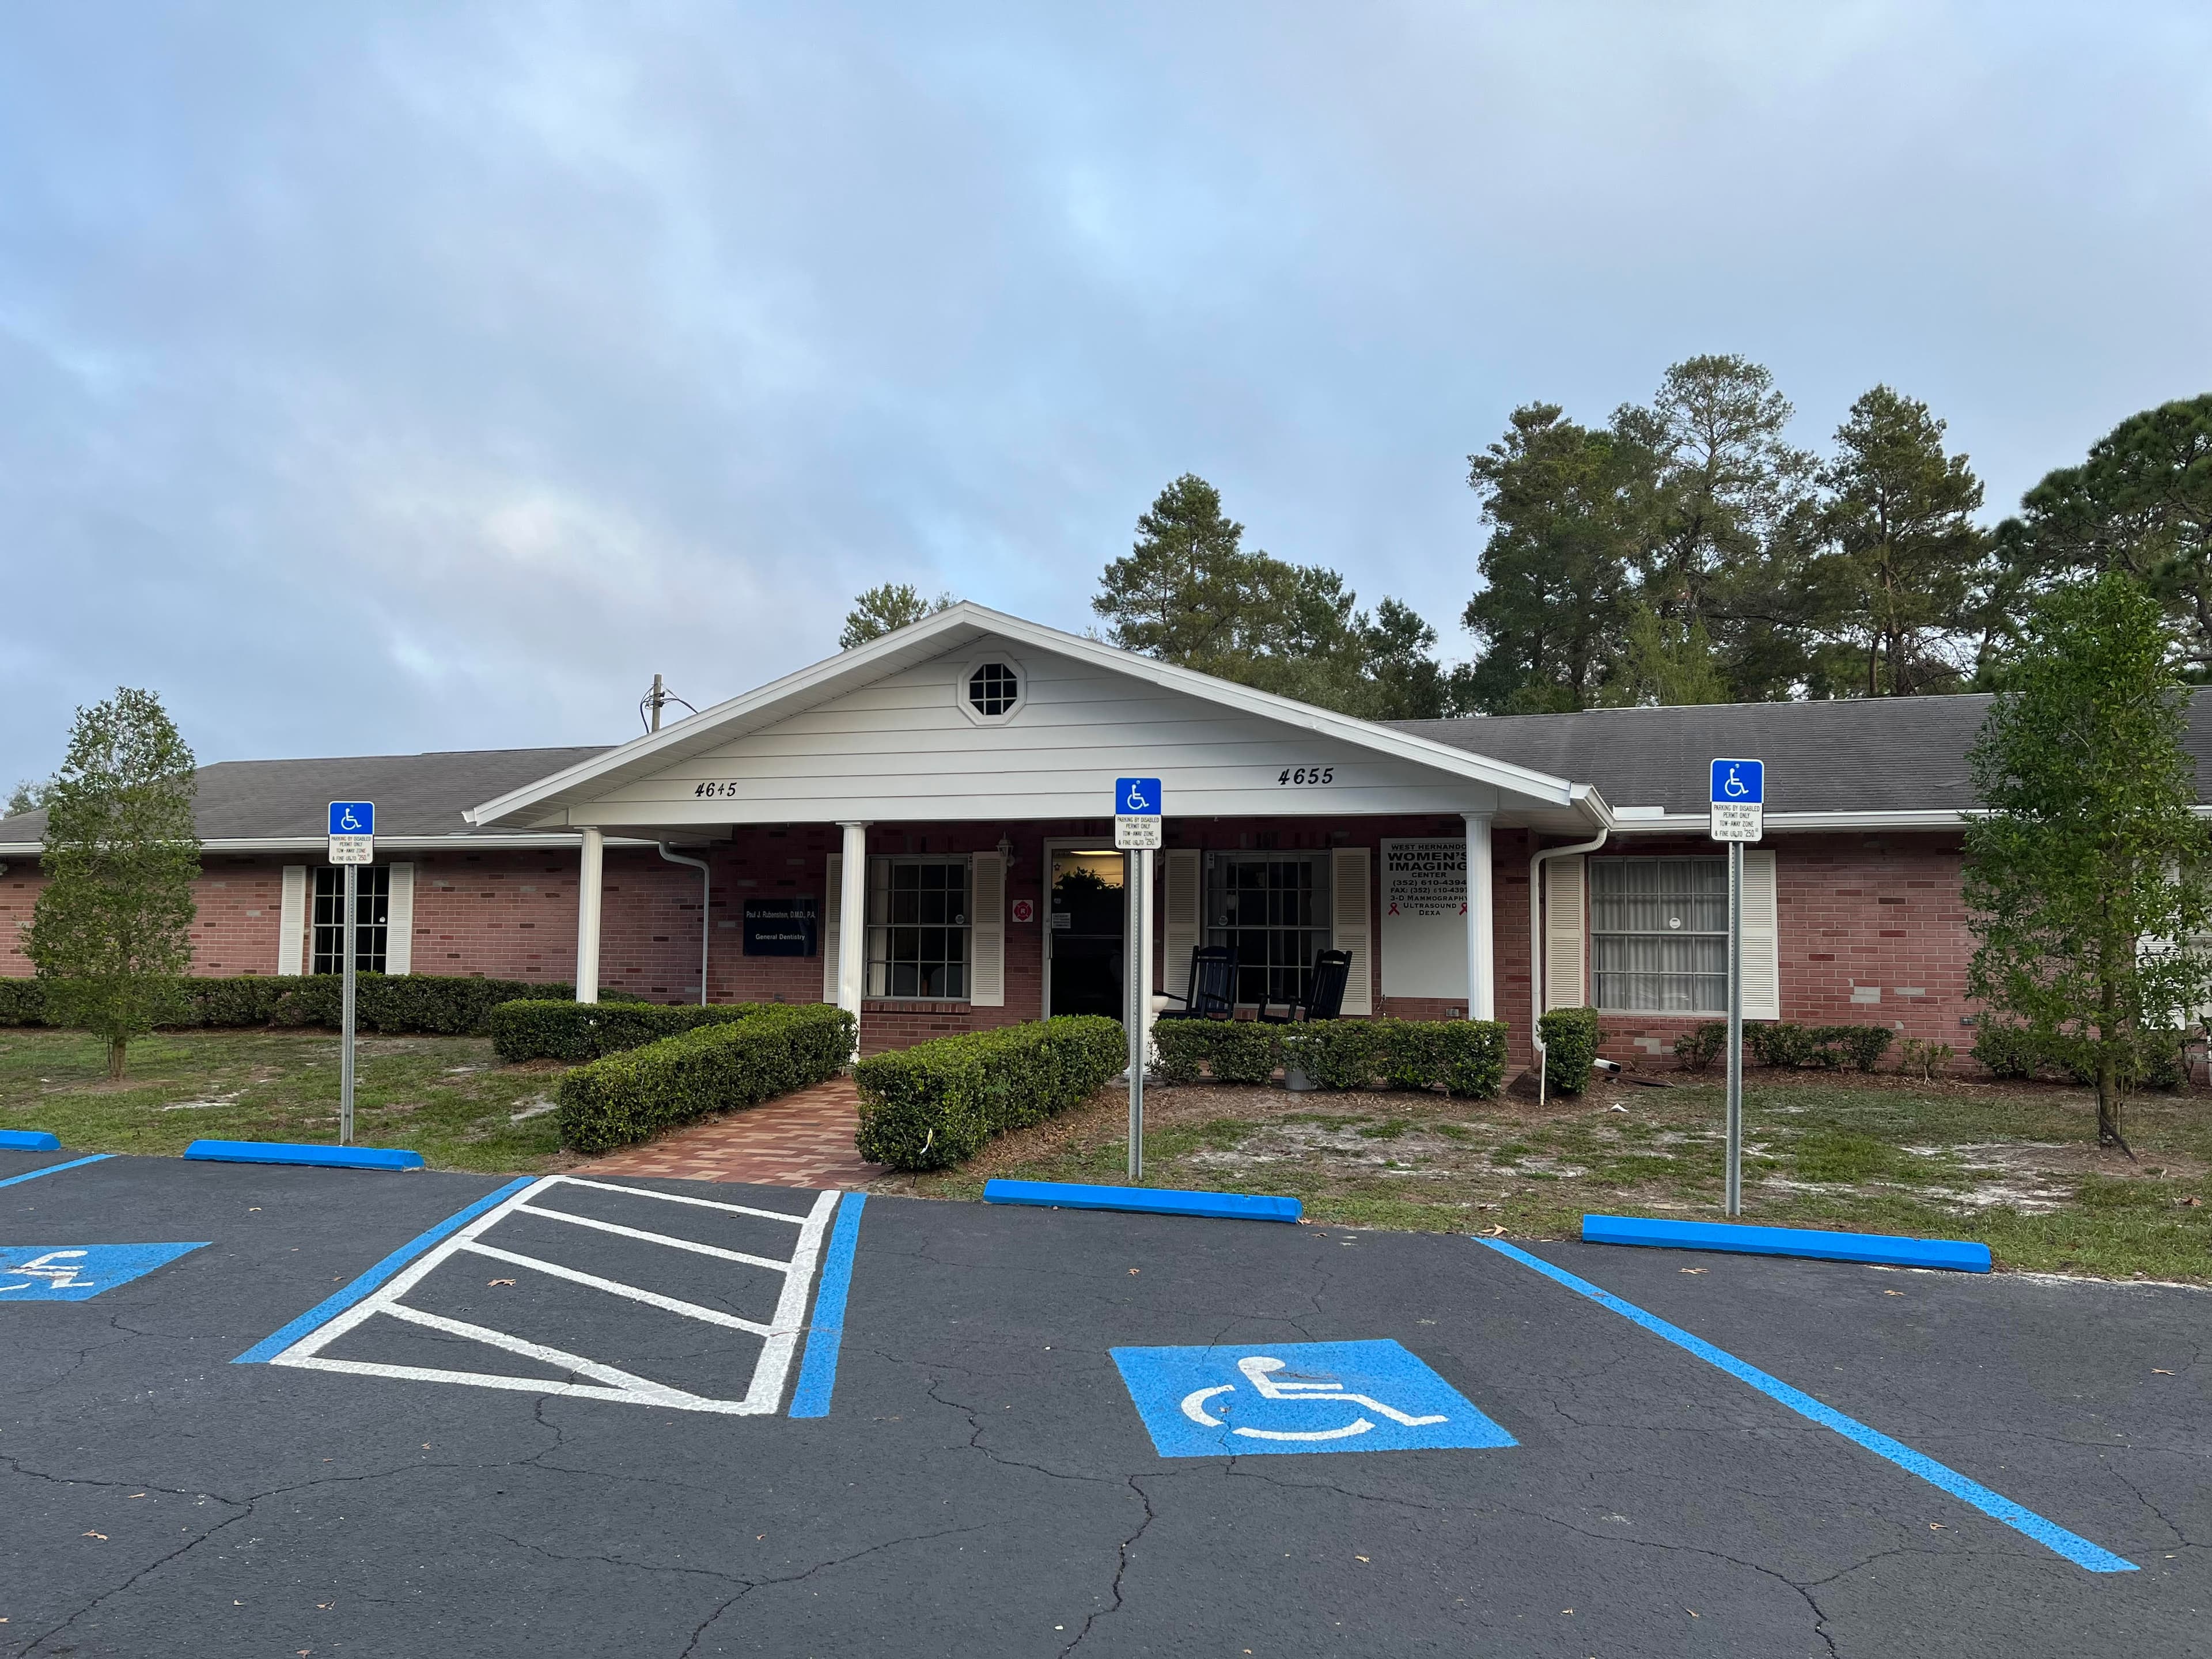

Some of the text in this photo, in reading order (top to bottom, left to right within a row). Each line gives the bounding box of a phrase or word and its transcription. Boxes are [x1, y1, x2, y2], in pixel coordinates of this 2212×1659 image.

[1278, 767, 1334, 785] 4655
[695, 782, 737, 797] 4645
[1388, 852, 1467, 861] WOMEN'S
[1389, 862, 1467, 871] IMAGING
